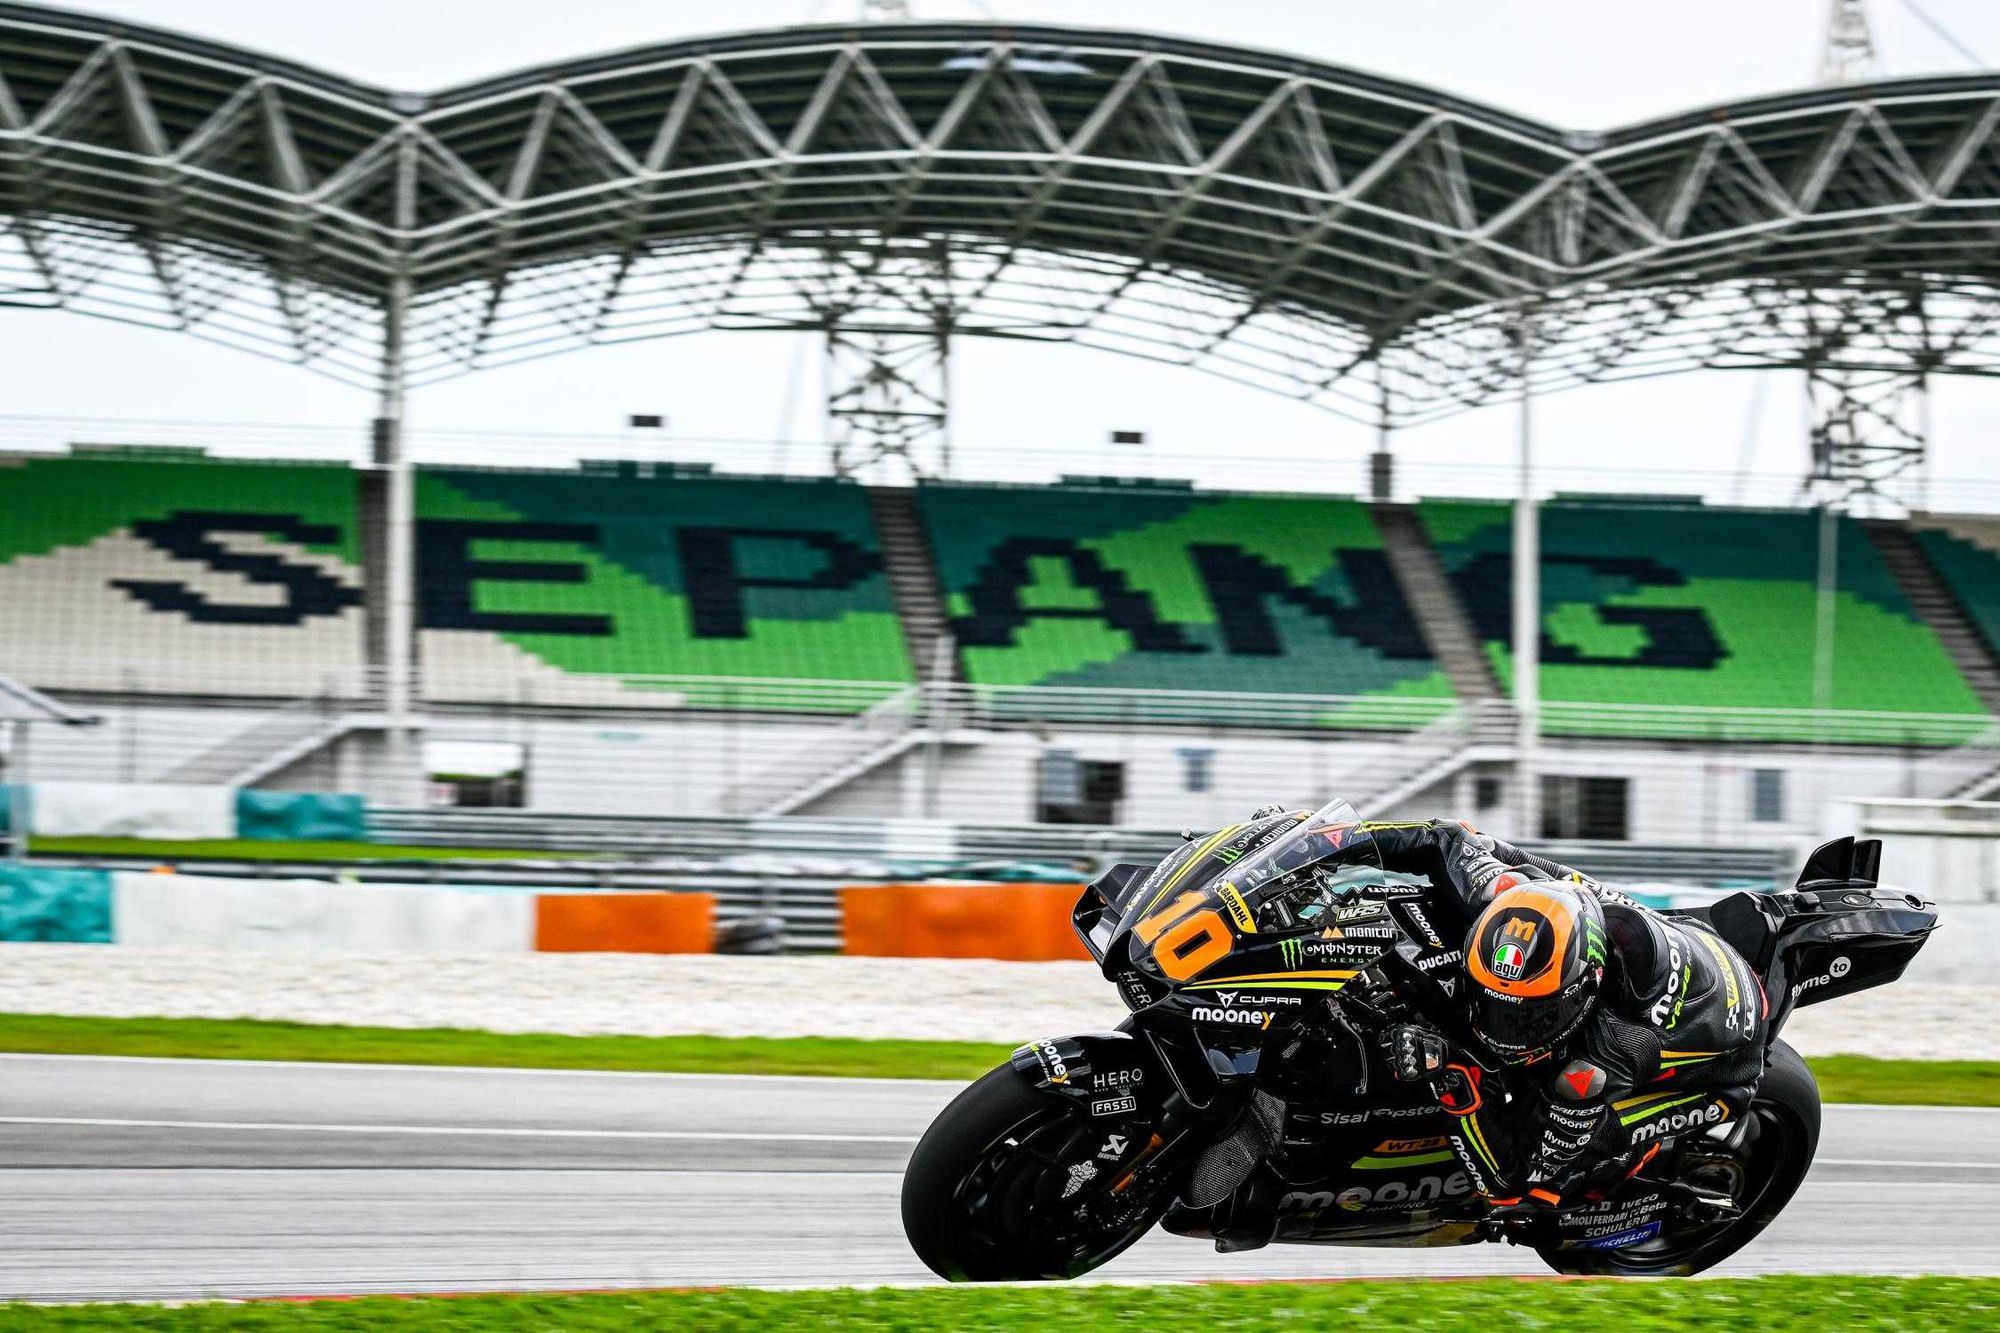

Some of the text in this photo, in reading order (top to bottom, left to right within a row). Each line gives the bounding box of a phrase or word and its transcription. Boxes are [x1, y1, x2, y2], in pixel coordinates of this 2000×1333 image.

[108, 510, 1729, 669] SEPANG
[1220, 887, 1249, 926] BARDAHL
[1338, 904, 1382, 920] WRS
[1345, 927, 1394, 939] monitor
[1407, 903, 1445, 948] mooney
[1132, 889, 1235, 983] 10
[1313, 942, 1383, 956] MONSTER
[1418, 950, 1461, 971] DUCATI
[1495, 962, 1519, 977] agv
[1122, 970, 1151, 1011] HER
[1484, 988, 1523, 1005] mooney
[1240, 996, 1302, 1005] CUPRA
[1192, 1007, 1275, 1030] mooney
[1038, 1040, 1071, 1085] ooney
[1093, 1068, 1142, 1088] HERO
[1096, 1100, 1133, 1113] FASSI
[1320, 1111, 1369, 1124] Sisal
[1549, 1112, 1598, 1130] mooney
[1278, 1171, 1471, 1210] moone
[1621, 1194, 1659, 1210] IVECO
[1640, 1202, 1667, 1214] Beta
[1585, 1218, 1641, 1238] SCHULER
